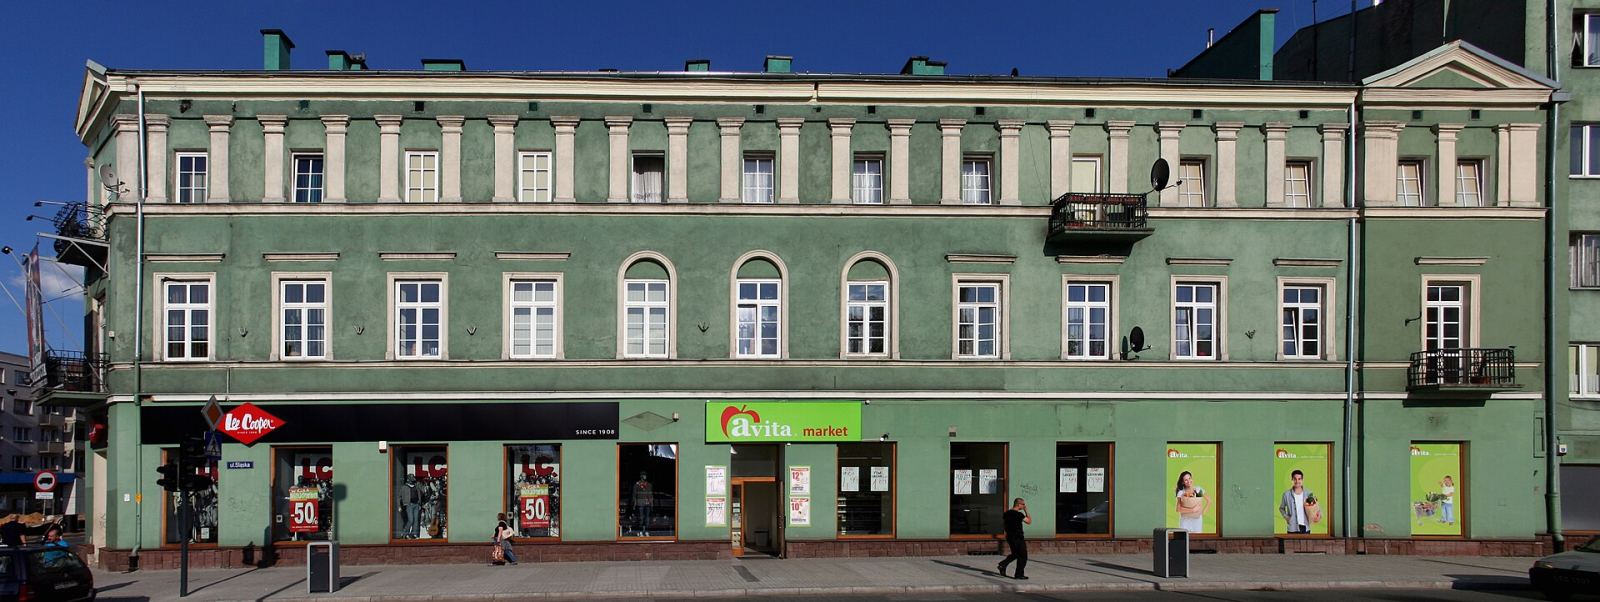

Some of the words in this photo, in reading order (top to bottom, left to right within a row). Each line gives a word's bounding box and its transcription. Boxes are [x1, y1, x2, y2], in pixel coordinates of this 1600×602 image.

[225, 413, 240, 431] Lee
[242, 413, 276, 434] Cooper
[731, 417, 793, 437] avita
[803, 425, 848, 437] market
